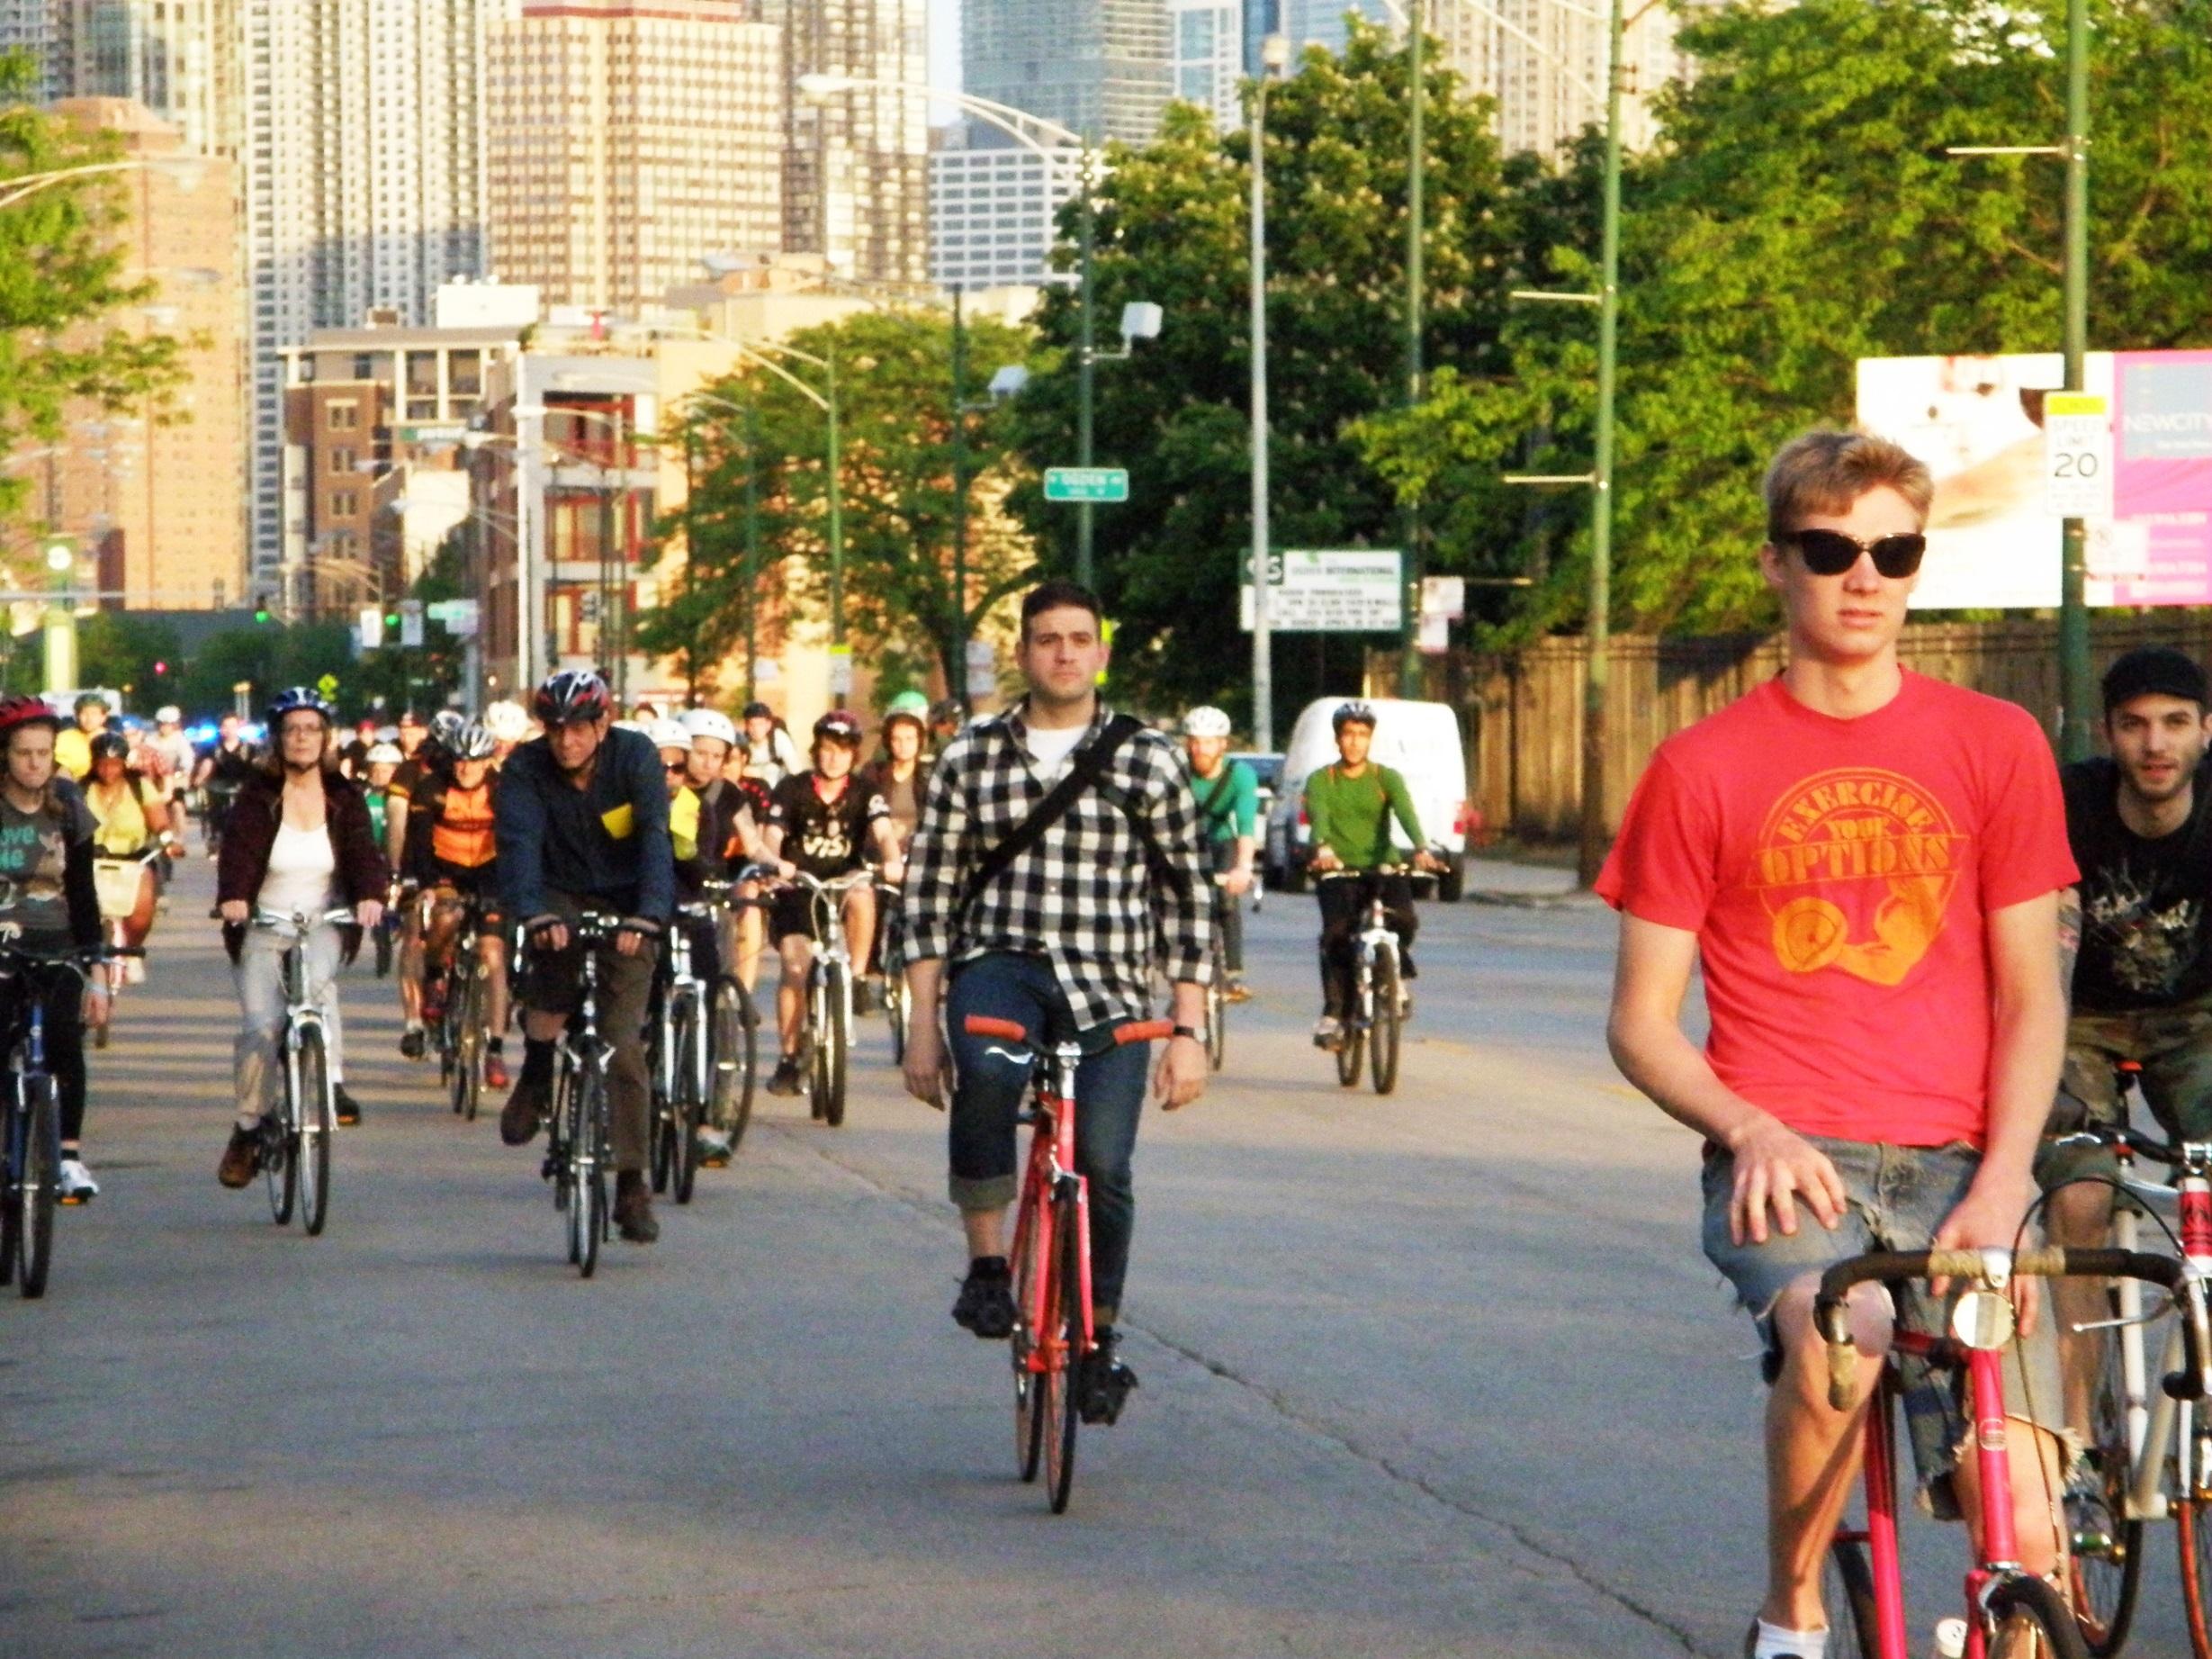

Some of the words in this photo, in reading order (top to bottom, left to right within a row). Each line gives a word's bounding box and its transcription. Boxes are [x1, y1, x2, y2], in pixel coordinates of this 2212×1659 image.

[2052, 419, 2103, 433] SPEED
[2057, 436, 2095, 447] LIMIT
[2054, 452, 2099, 479] 20
[1778, 780, 1936, 843] EXERCISE
[1827, 816, 1892, 841] YOUR
[1761, 834, 1949, 884] OPTIONS
